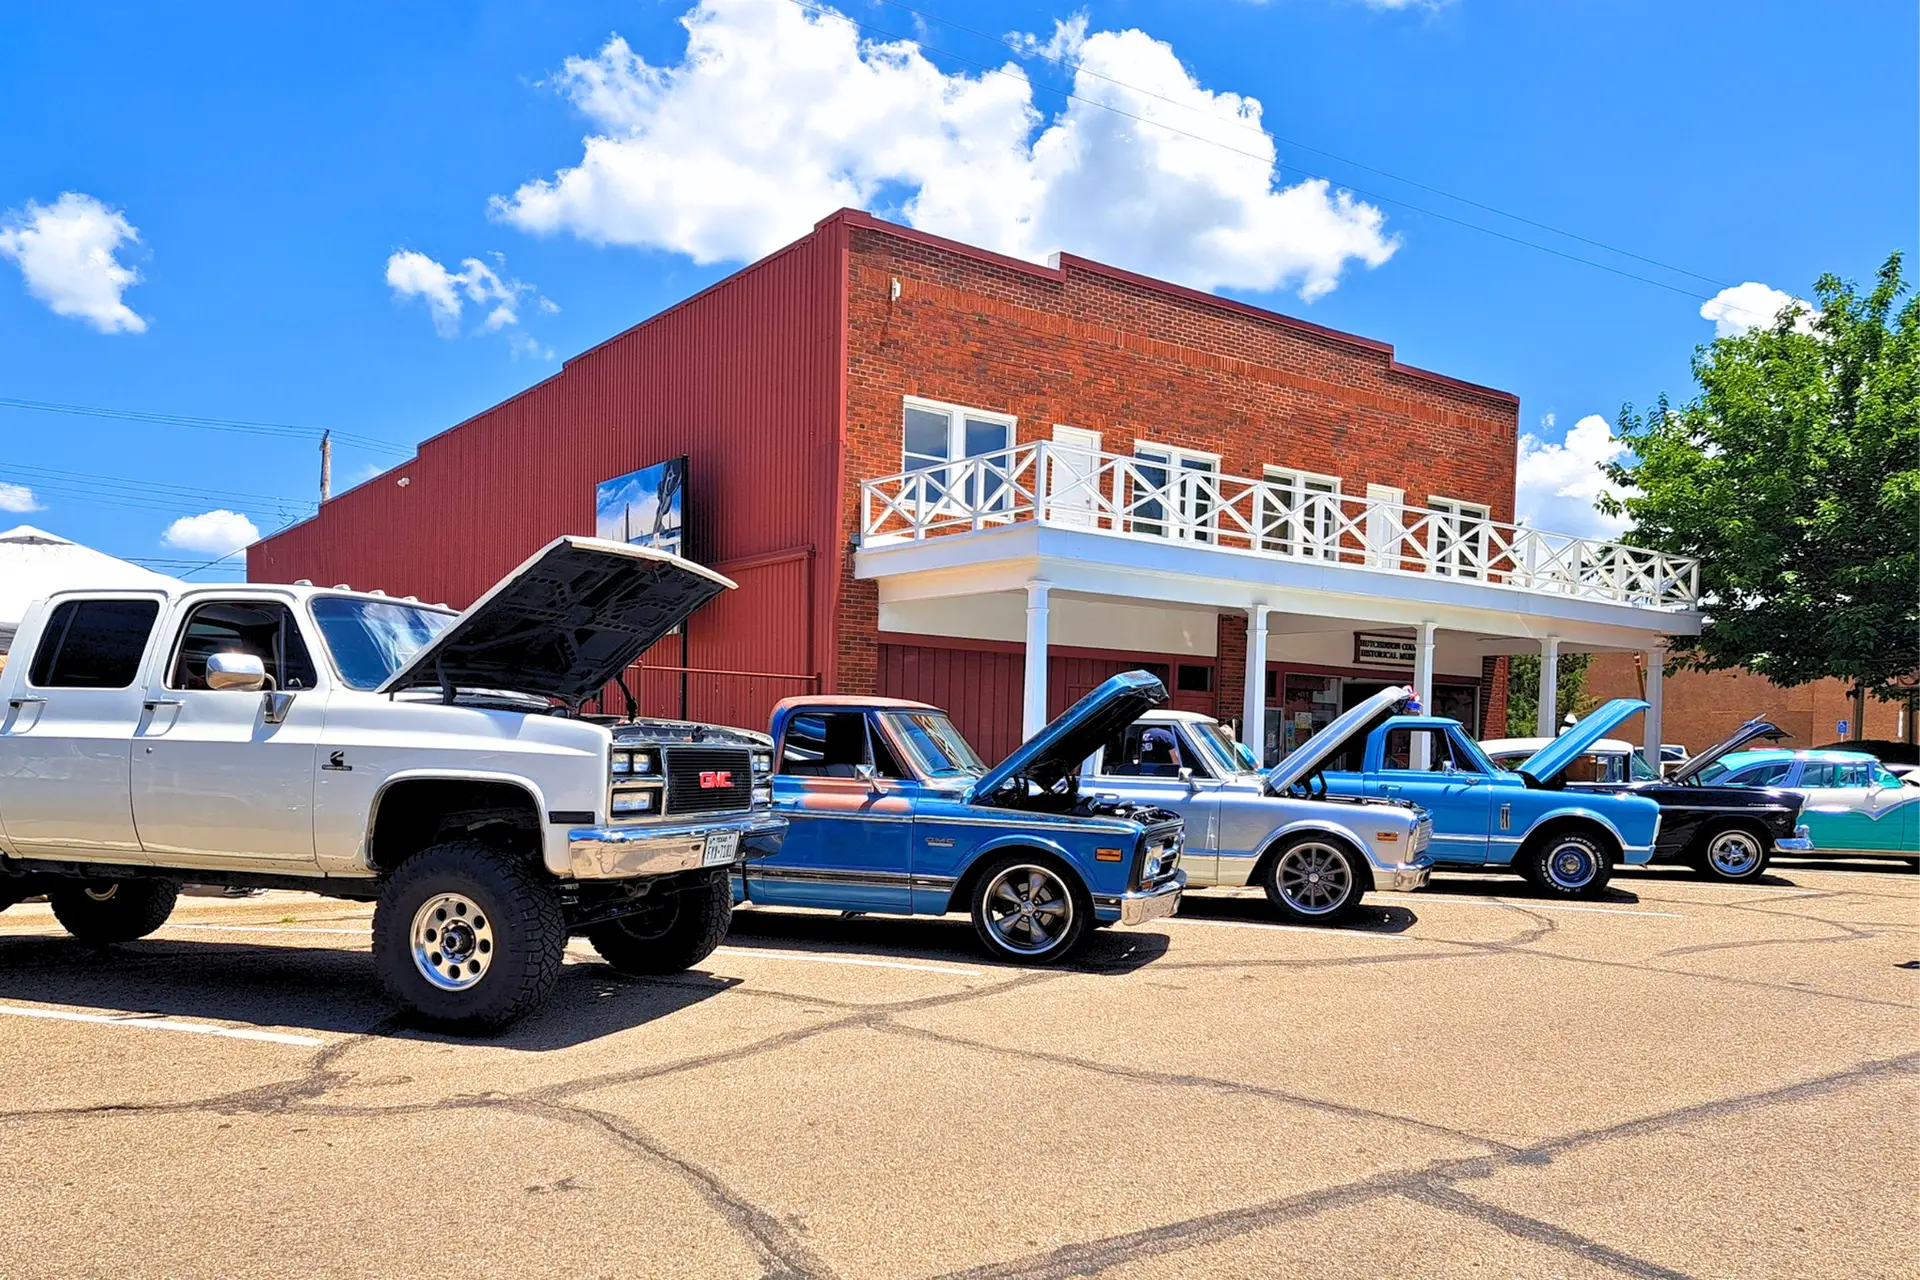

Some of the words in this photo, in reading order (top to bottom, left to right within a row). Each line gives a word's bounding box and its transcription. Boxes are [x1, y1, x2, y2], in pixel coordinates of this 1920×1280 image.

[1360, 650, 1398, 659] HISTORICAL
[699, 771, 734, 788] GMC
[1564, 836, 1597, 850] VENTUS
[1541, 859, 1571, 893] HANKOOK
